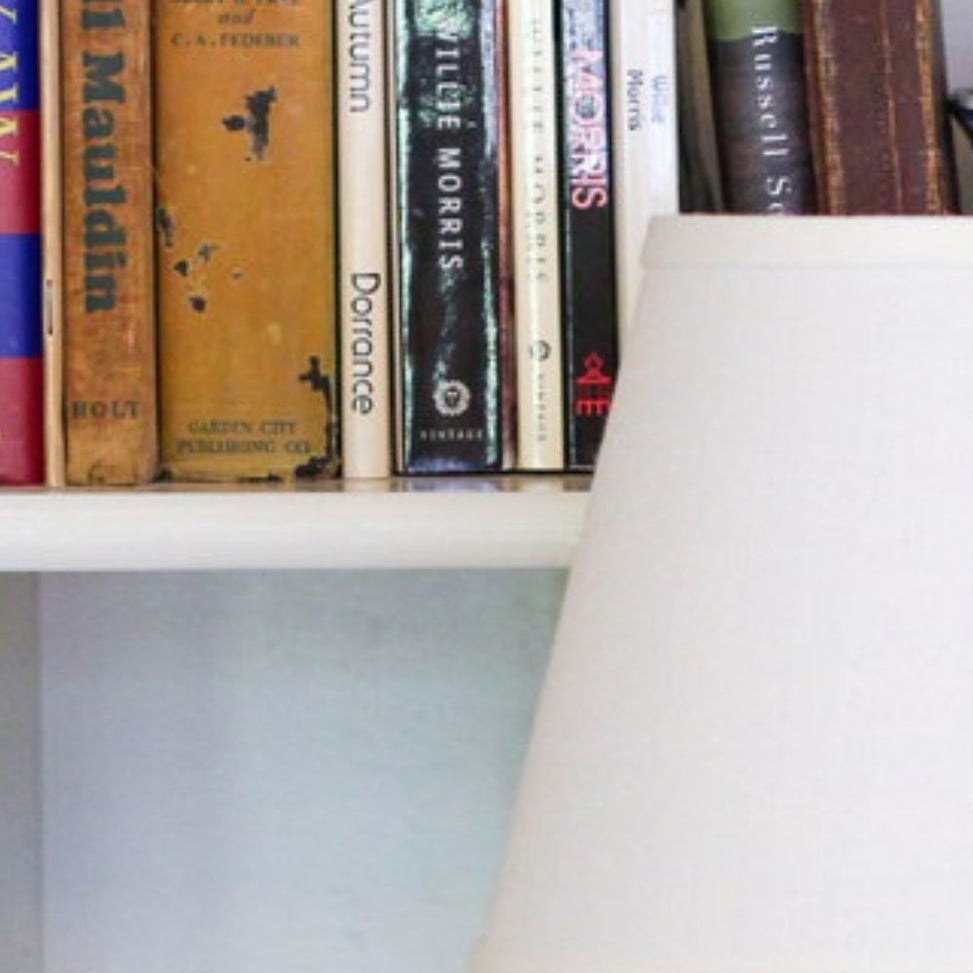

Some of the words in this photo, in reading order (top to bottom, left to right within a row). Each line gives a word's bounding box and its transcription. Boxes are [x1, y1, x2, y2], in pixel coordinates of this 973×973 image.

[435, 17, 462, 130] WILLIE
[570, 49, 608, 210] MORRIS
[751, 25, 790, 157] Russell
[82, 52, 126, 313] Mauldin
[437, 147, 463, 269] MORRIS
[350, 271, 381, 416] Dorrance
